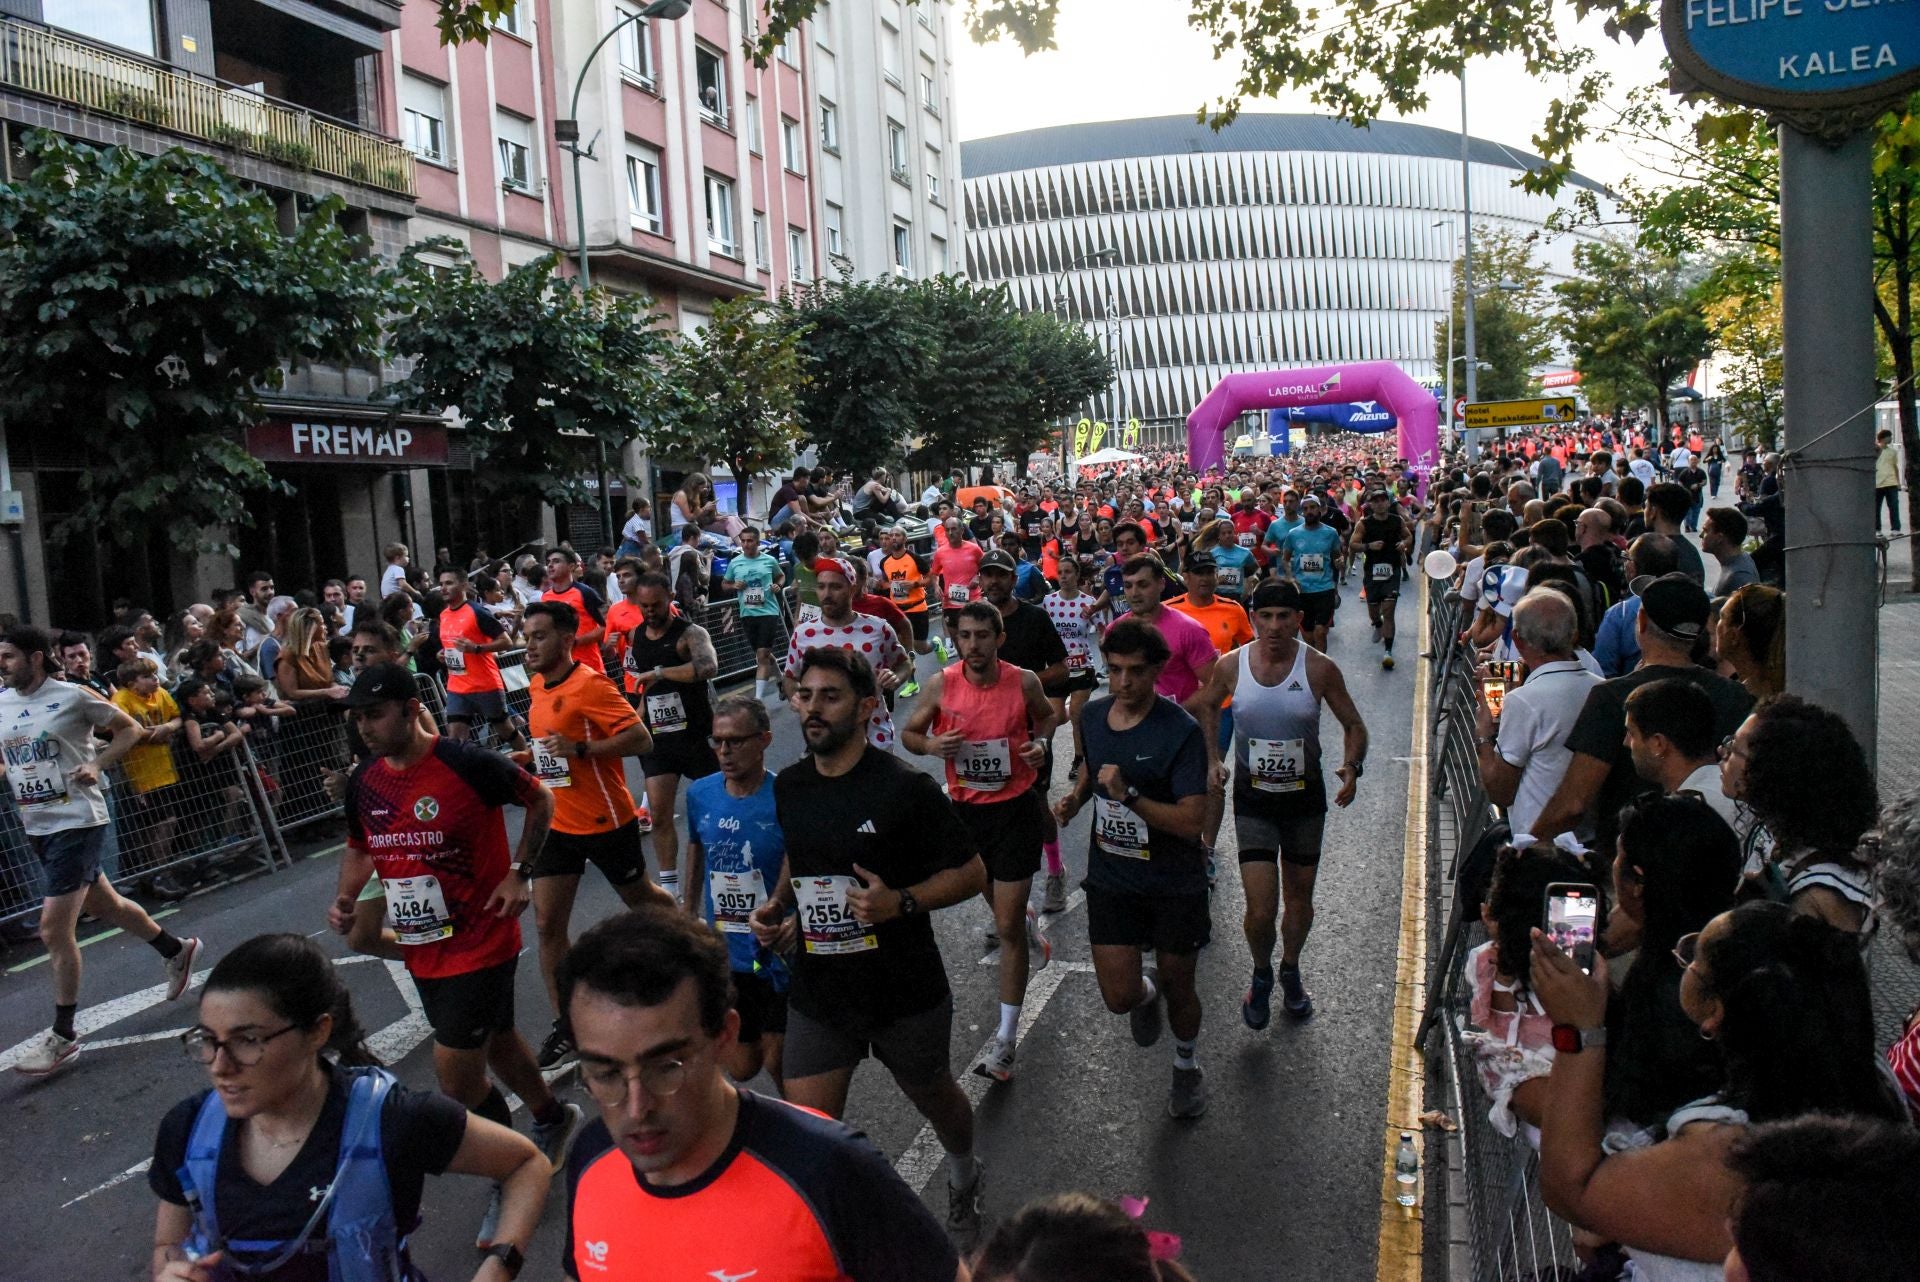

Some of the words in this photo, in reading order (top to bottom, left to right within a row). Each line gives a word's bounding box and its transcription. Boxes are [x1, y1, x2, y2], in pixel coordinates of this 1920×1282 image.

[1778, 43, 1897, 80] KALEA
[1268, 384, 1318, 397] LABORAL
[1467, 407, 1490, 415] Hotel
[292, 423, 412, 456] FREMAP
[653, 706, 678, 719] 2788
[538, 755, 557, 767] 506
[963, 757, 1002, 771] 1899
[1257, 758, 1296, 771] 3242
[18, 778, 53, 794] 2661
[718, 816, 740, 833] edp
[393, 899, 434, 918] 3484
[717, 893, 756, 909] 3057
[806, 903, 855, 924] 2554
